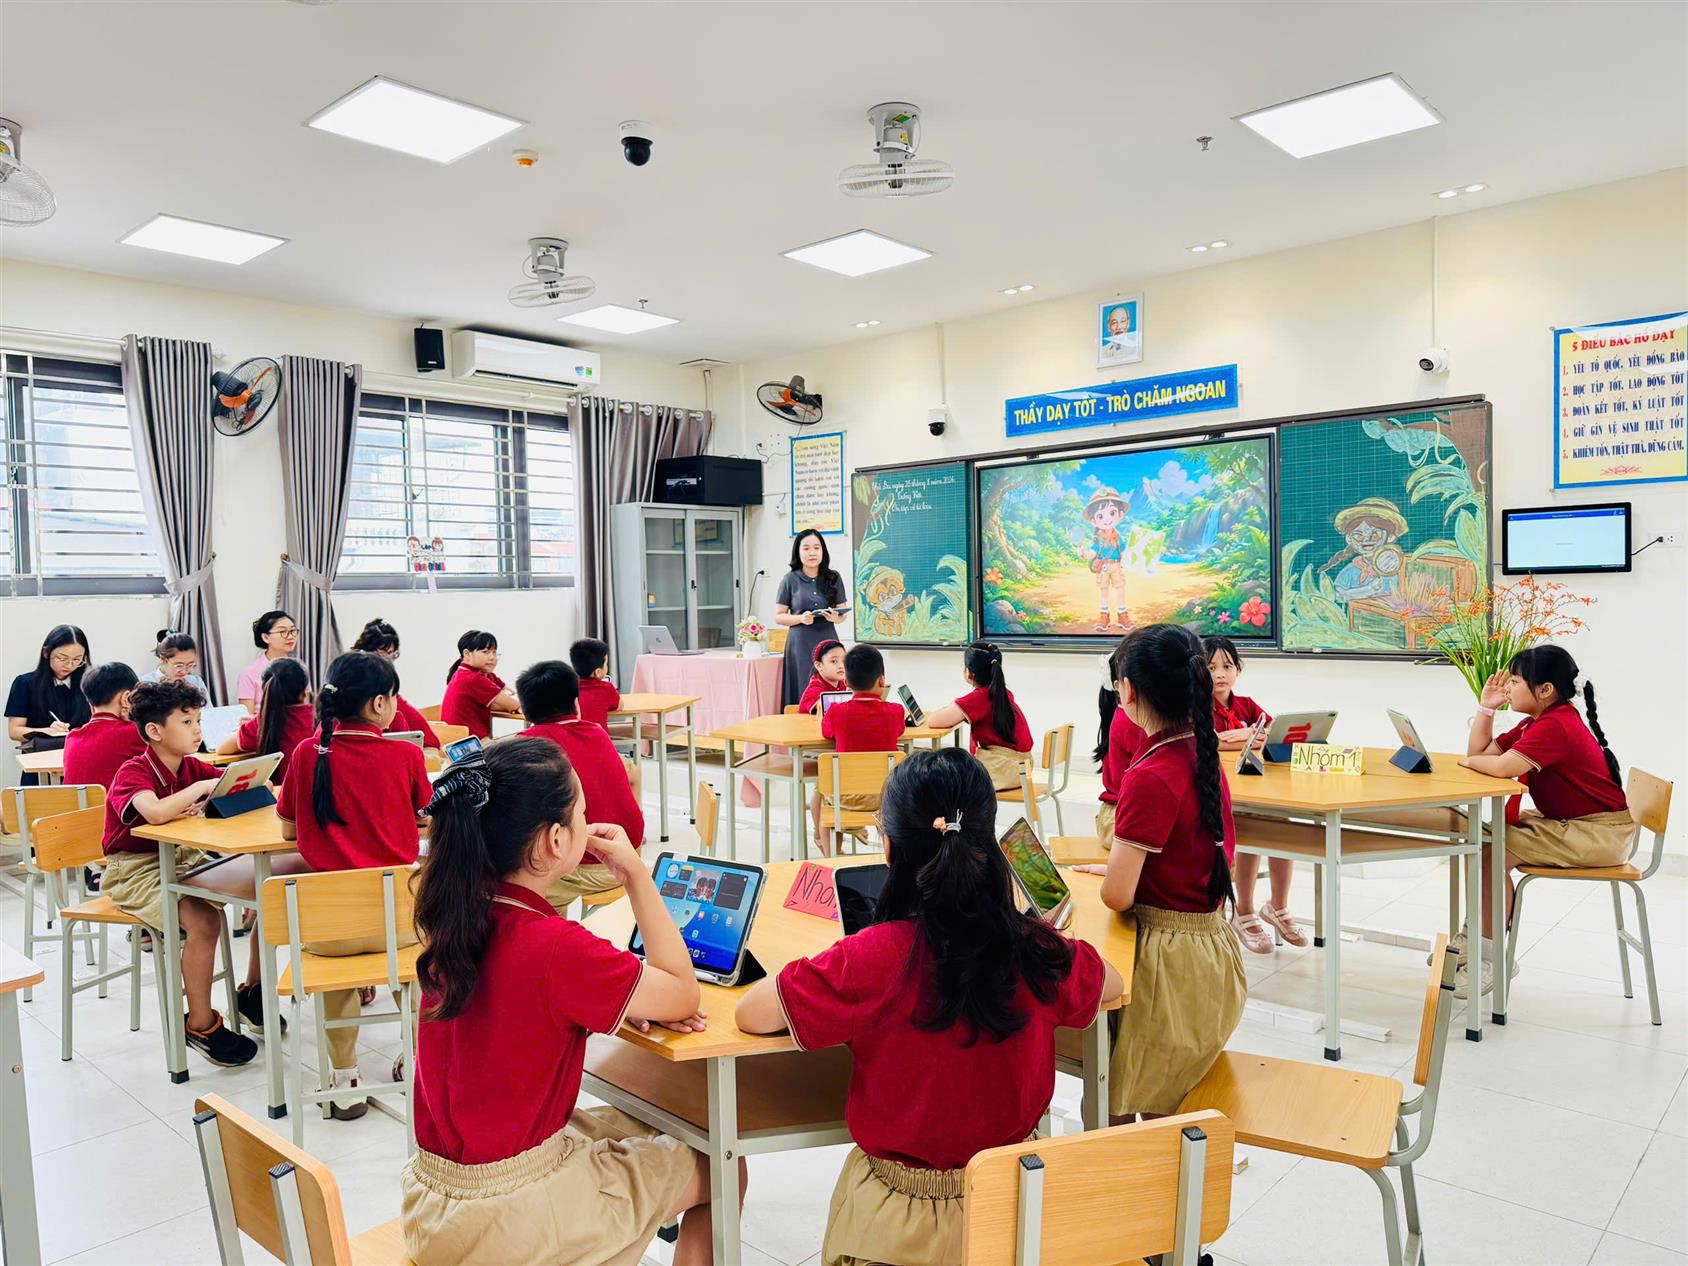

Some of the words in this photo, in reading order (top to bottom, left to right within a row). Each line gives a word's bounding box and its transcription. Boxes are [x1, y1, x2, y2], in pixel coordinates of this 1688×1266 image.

[1572, 342, 1578, 352] 5
[1628, 378, 1642, 390] LAO
[1014, 401, 1044, 426] THẦY
[1046, 405, 1072, 426] DẠY
[1106, 389, 1131, 413] TRÒ
[1134, 385, 1173, 409] CHĂM
[1175, 380, 1226, 403] NGOAN
[1621, 421, 1639, 433] SINH
[1298, 745, 1345, 767] Nhóm
[1348, 751, 1357, 768] 1
